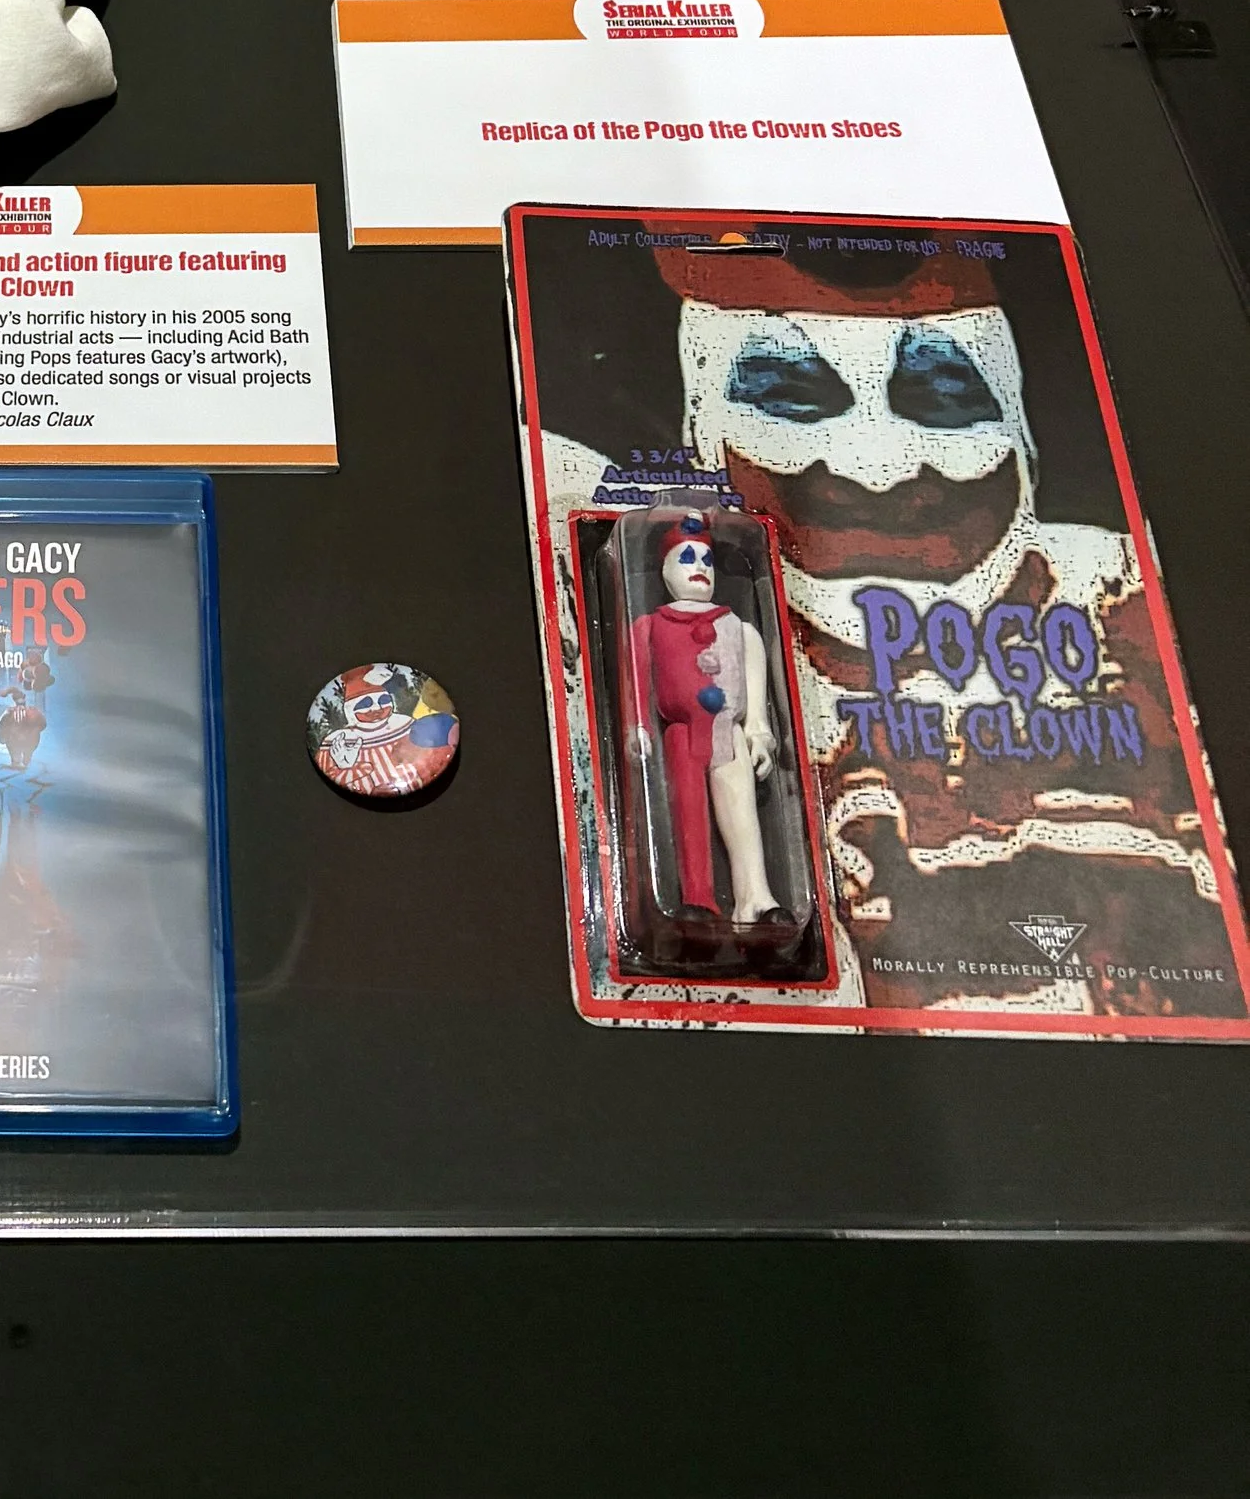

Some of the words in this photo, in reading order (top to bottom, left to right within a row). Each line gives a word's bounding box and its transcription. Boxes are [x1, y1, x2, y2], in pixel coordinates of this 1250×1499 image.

[482, 121, 568, 143] Replica
[574, 121, 596, 140] of
[602, 121, 640, 140] the
[645, 121, 704, 141] Pogo
[709, 120, 748, 139] the
[752, 120, 827, 138] Clown
[832, 120, 902, 138] shoes
[588, 229, 631, 247] ADULT
[26, 252, 98, 272] action
[104, 251, 172, 274] figure
[179, 250, 287, 273] featuring
[1, 277, 74, 296] Clown
[27, 311, 84, 325] horrific
[91, 311, 146, 328] history
[152, 310, 166, 324] in
[173, 310, 196, 324] his
[202, 310, 245, 324] 2005
[251, 312, 291, 326] song
[79, 330, 114, 344] acts
[148, 330, 223, 346] including
[228, 330, 264, 344] Acid
[270, 329, 309, 344] Bath
[30, 350, 70, 367] Pops
[76, 350, 145, 364] features
[151, 350, 205, 367] Gacy’s
[211, 349, 288, 366] artwork),
[20, 370, 102, 385] dedicated
[109, 373, 159, 388] songs
[164, 373, 182, 384] or
[188, 370, 236, 384] visual
[242, 370, 312, 388] projects
[2, 391, 58, 406] Clown.
[46, 412, 94, 427] Claux
[631, 449, 644, 463] 3
[602, 466, 729, 484] Articulated
[5, 542, 81, 574] GACY
[854, 588, 1099, 712] POGO
[841, 700, 945, 759] THE
[965, 701, 1143, 767] CLOWN
[872, 958, 945, 973] MORALLY
[958, 959, 1095, 979] REPREHENSIBLE
[1107, 965, 1225, 982] POP-CULTURE
